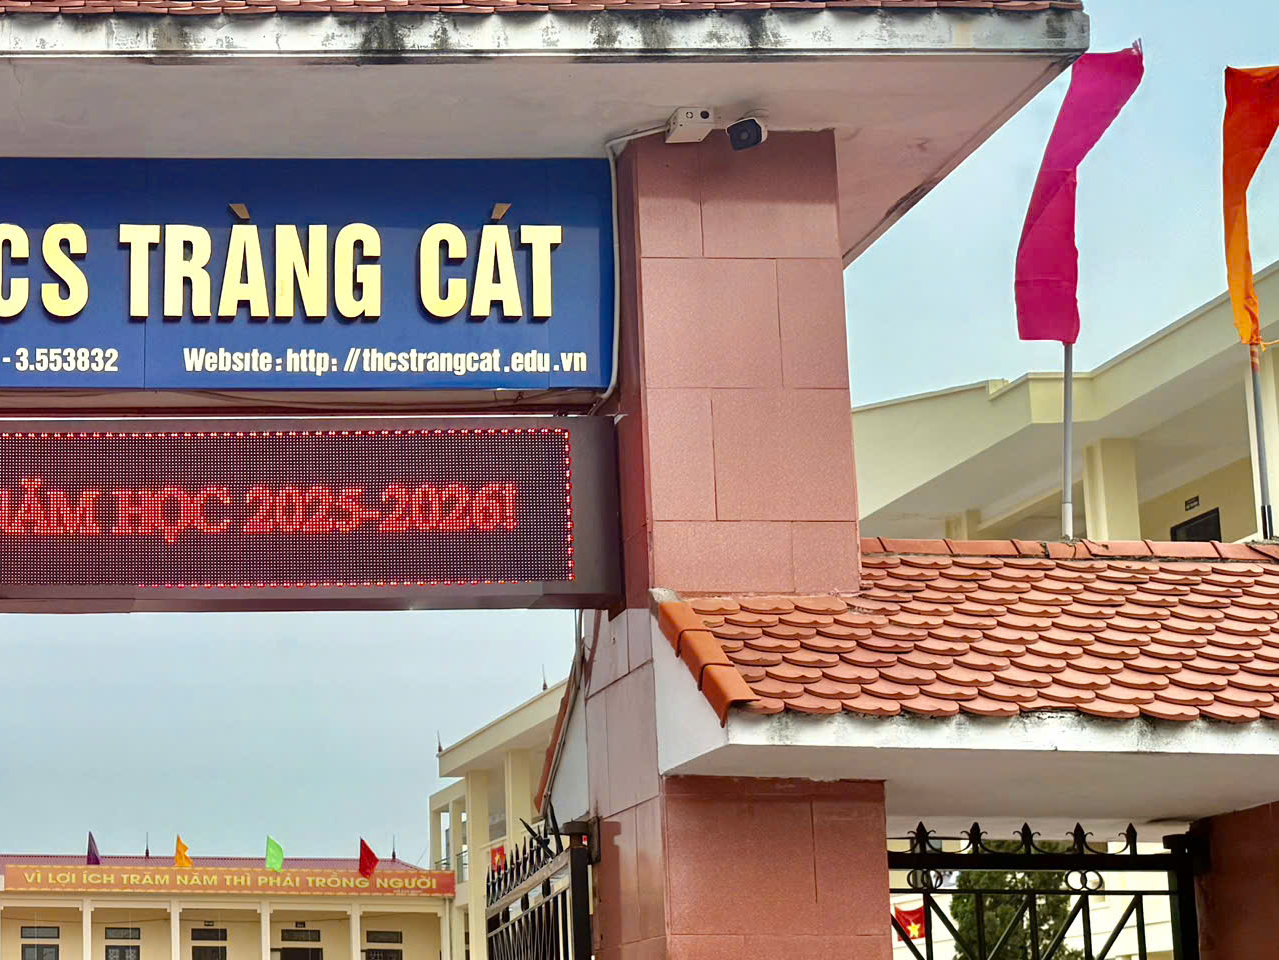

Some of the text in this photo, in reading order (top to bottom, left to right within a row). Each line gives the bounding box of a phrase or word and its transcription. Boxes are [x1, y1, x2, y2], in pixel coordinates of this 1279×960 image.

[119, 203, 381, 320] TRÀNG
[420, 203, 562, 320] CÁT
[15, 347, 119, 373] 3.553832
[112, 486, 231, 543] HỌC
[23, 871, 437, 890] VÌ LỢI ÍCH TRĂM NĂM THÌ PHẢI TRỒNG NGƯỜI
